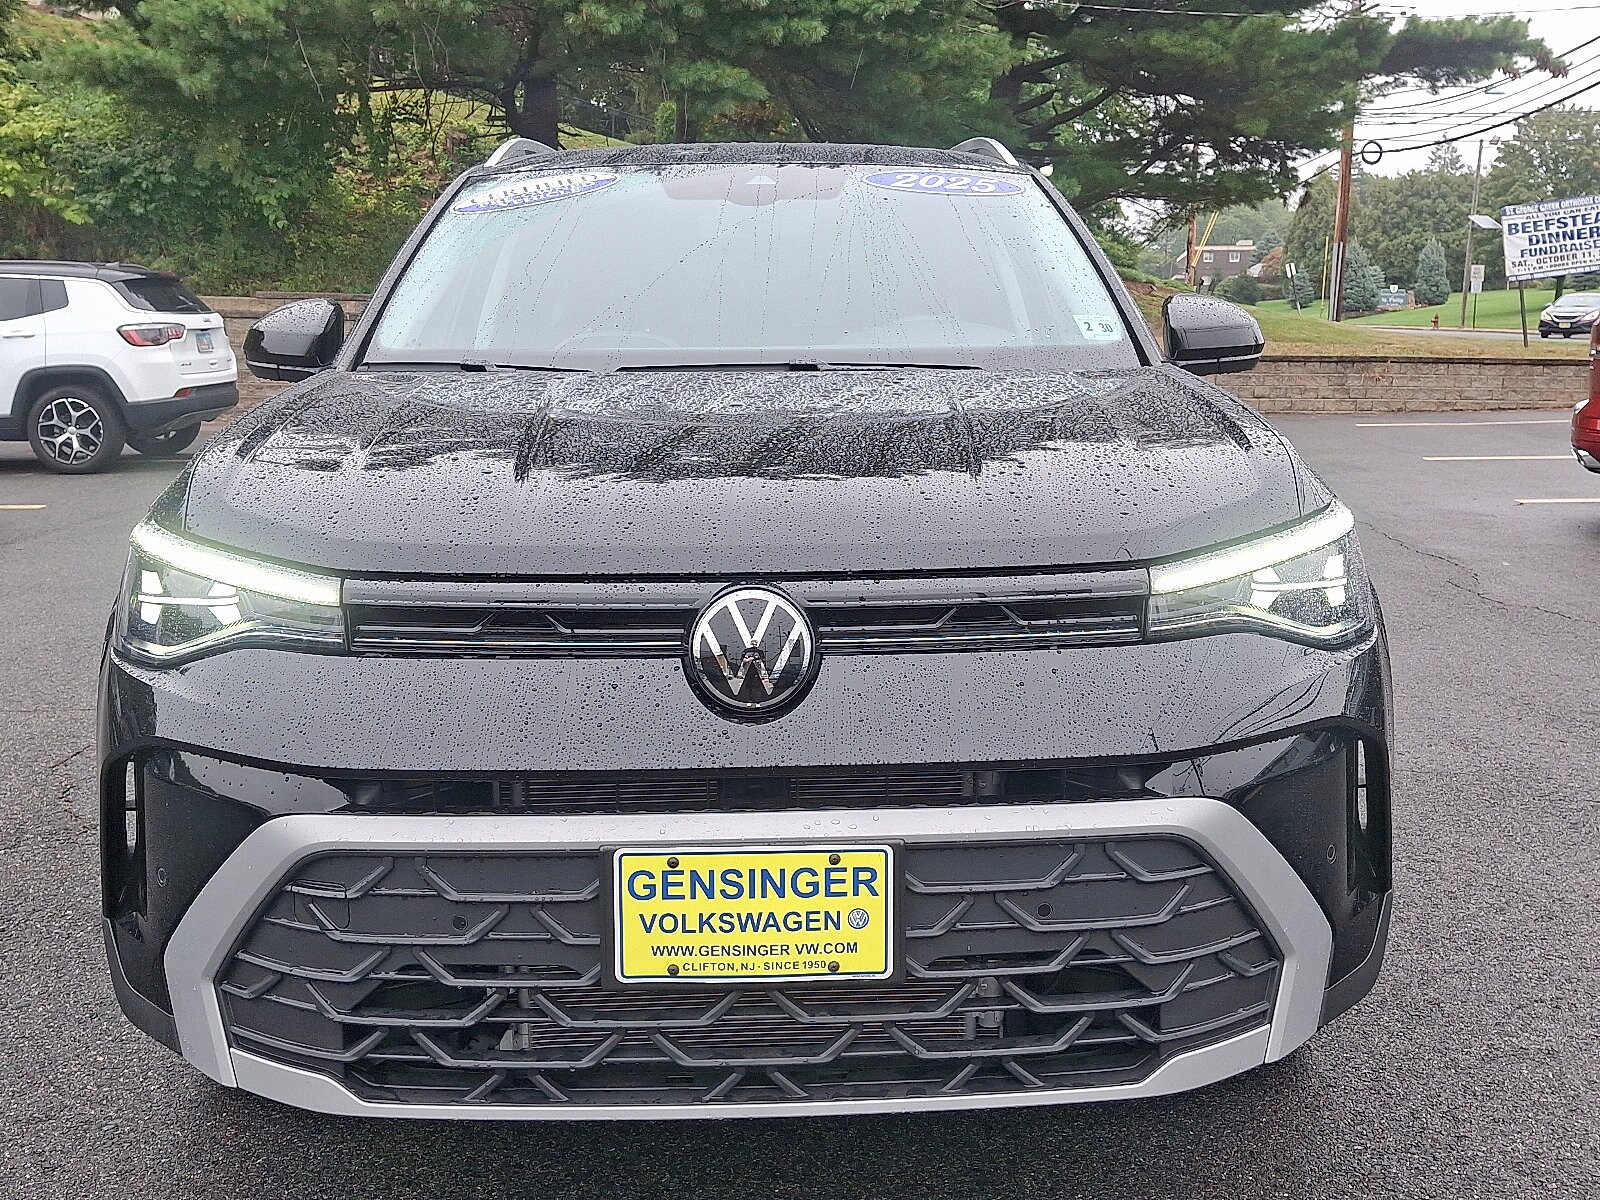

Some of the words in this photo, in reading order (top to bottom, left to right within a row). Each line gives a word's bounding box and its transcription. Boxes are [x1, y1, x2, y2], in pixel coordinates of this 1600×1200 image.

[890, 174, 997, 192] 2025
[1561, 197, 1594, 209] ORTHODOX
[1528, 226, 1600, 246] DINNER
[1536, 253, 1578, 265] OCTOBER
[1084, 321, 1094, 331] 2
[1098, 323, 1113, 332] 30
[627, 867, 880, 901] GENSINGER
[638, 911, 841, 933] VOLKSWAGEN
[651, 944, 790, 957] WWW.GENSINGER
[795, 942, 858, 956] VW.COM
[682, 962, 739, 972] CLIFTON,
[740, 962, 755, 971] NJ
[763, 961, 801, 970] SINCE
[802, 960, 827, 970] 1950
